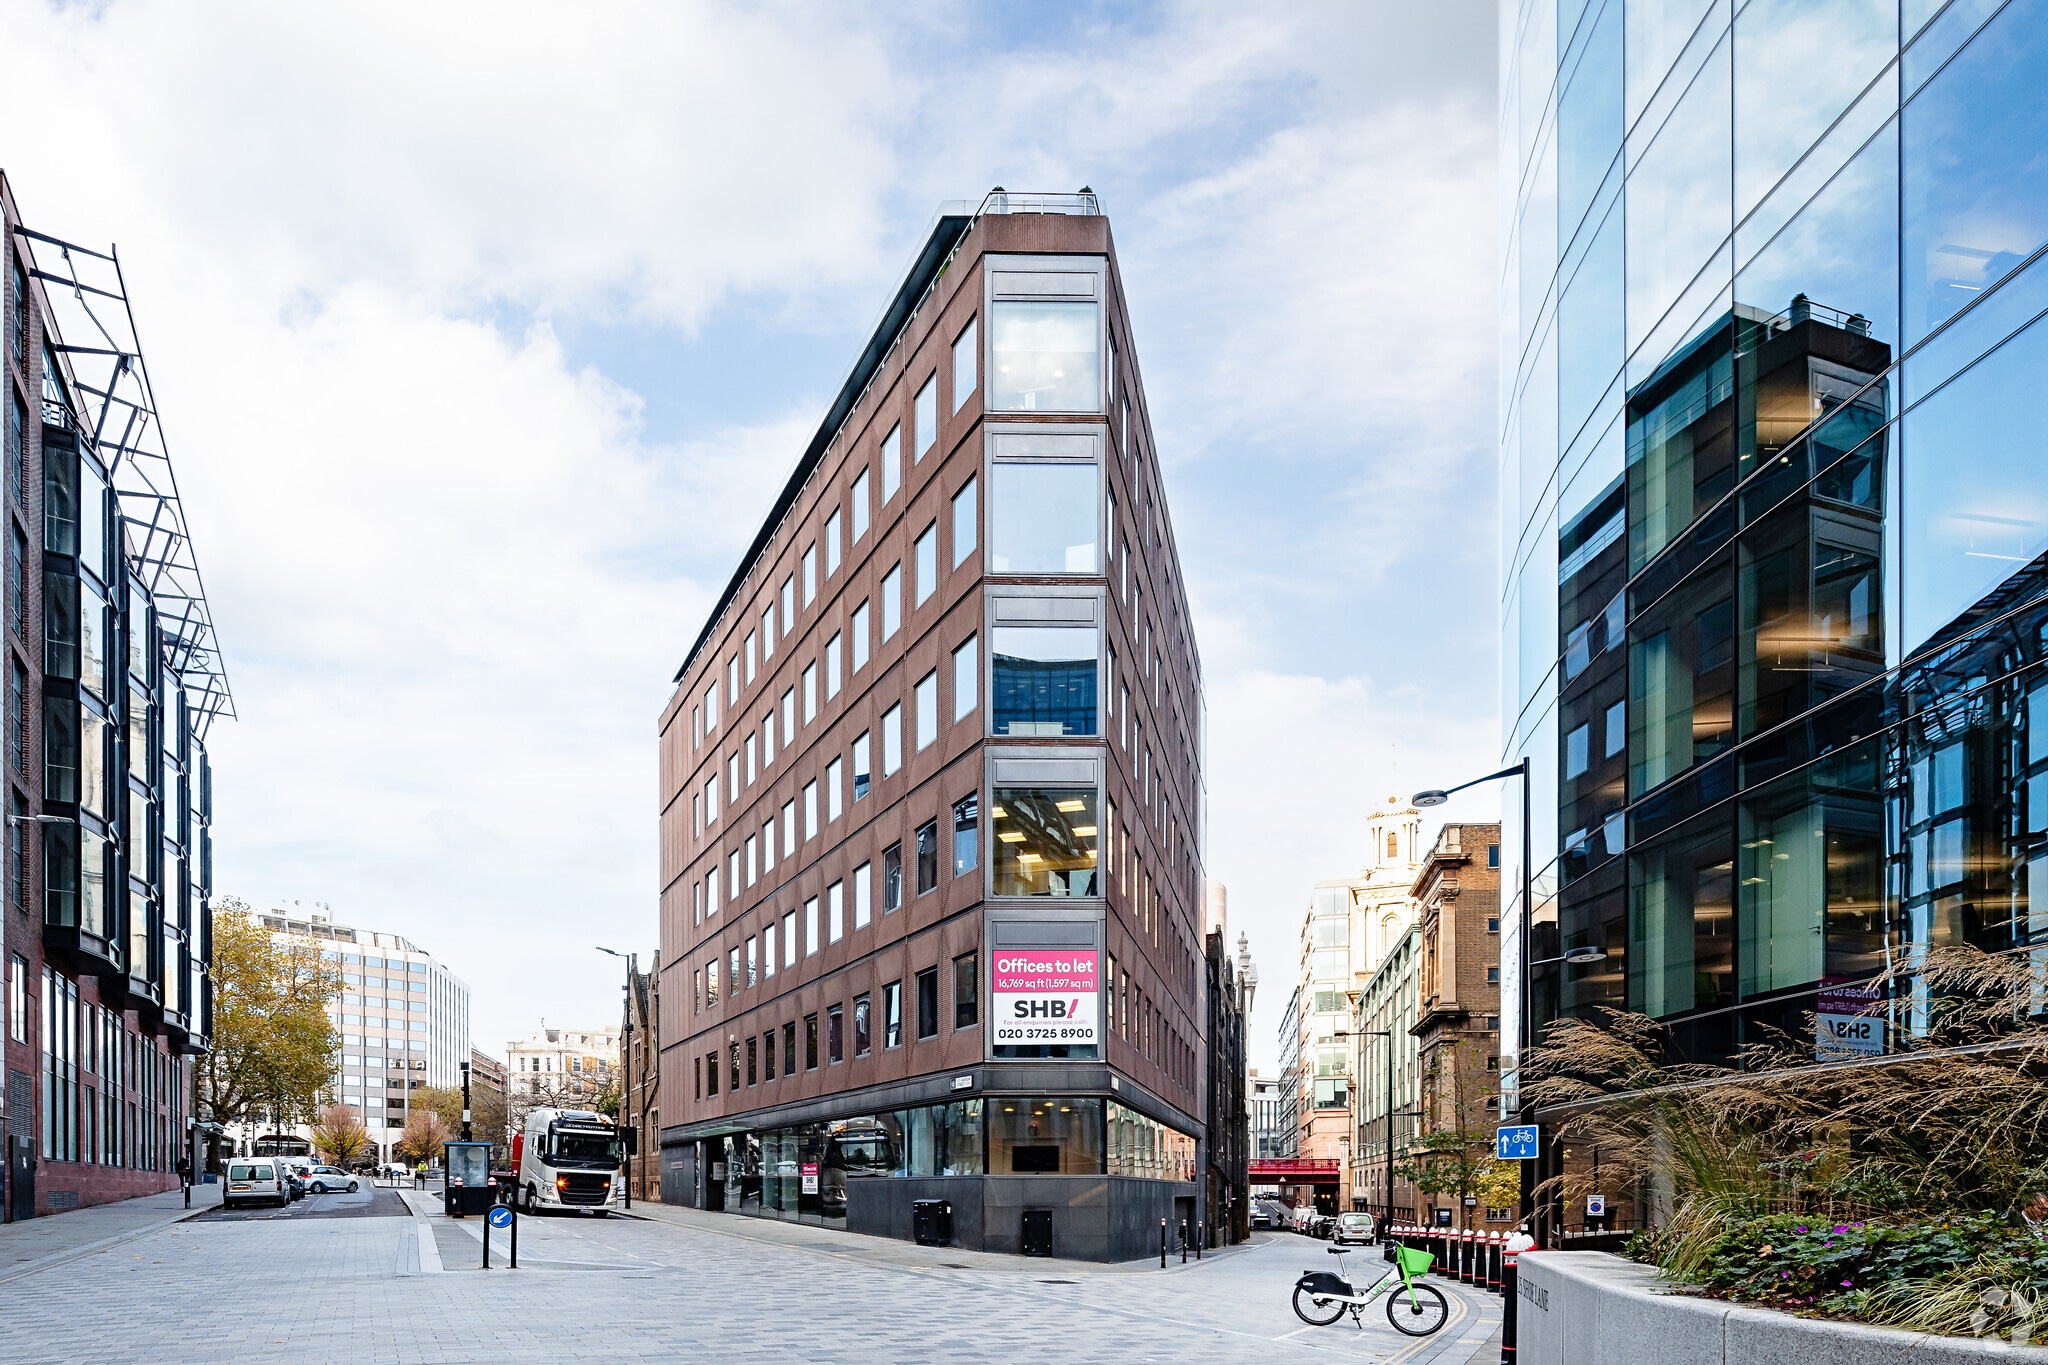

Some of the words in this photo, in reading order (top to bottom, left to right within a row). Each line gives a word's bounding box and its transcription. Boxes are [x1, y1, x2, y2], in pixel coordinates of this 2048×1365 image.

[998, 958, 1054, 973] Offices
[1055, 960, 1071, 973] to
[1073, 958, 1094, 973] let
[998, 978, 1024, 989] 16,769
[1025, 982, 1036, 990] sq
[1036, 978, 1045, 988] ft
[1045, 978, 1070, 989] (1,597
[1070, 982, 1081, 990] sq
[1082, 978, 1094, 989] m)
[998, 1029, 1023, 1038] 020
[1026, 1029, 1057, 1038] 3725
[1060, 1028, 1093, 1038] 8900
[1370, 1278, 1391, 1296] Lime
[1535, 1284, 1549, 1312] LANE
